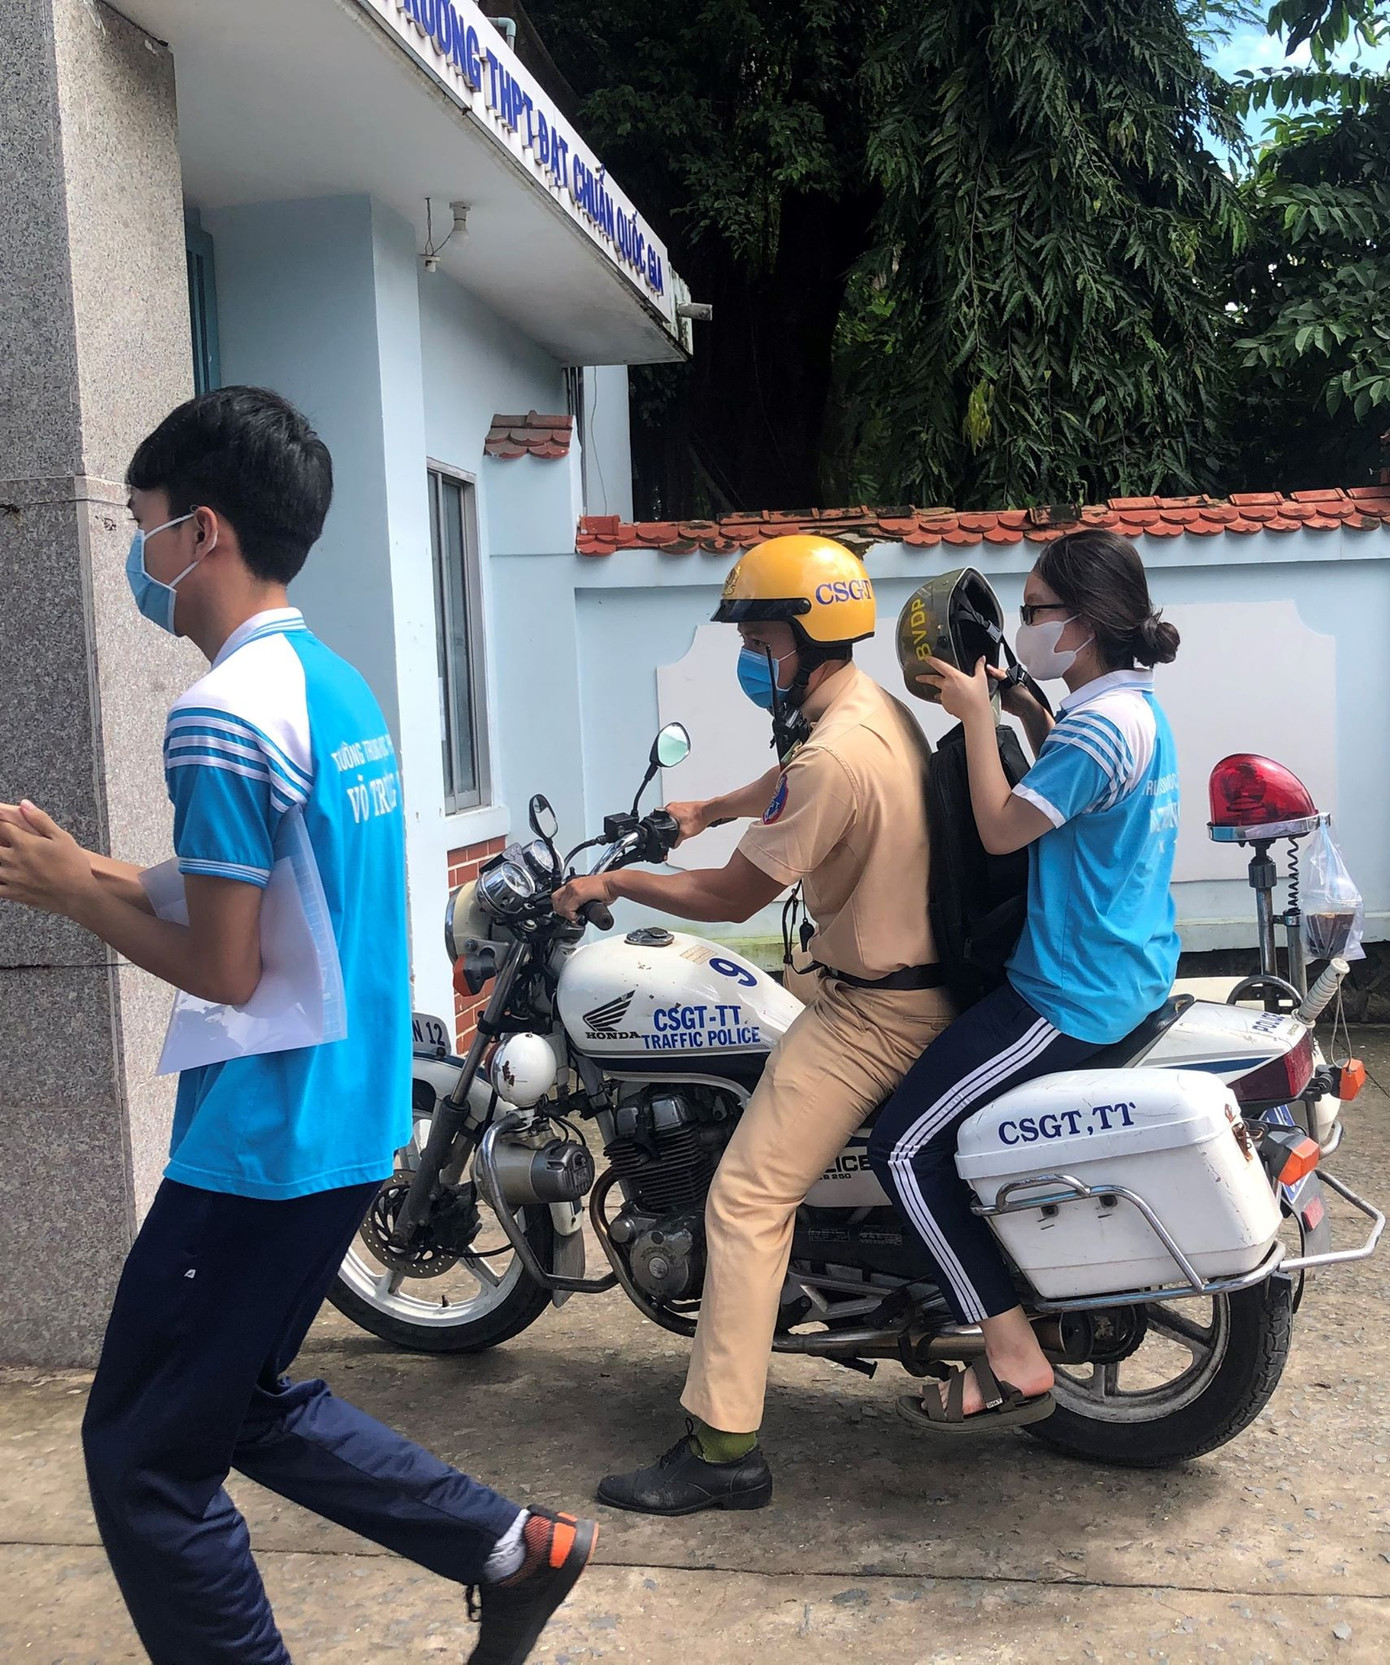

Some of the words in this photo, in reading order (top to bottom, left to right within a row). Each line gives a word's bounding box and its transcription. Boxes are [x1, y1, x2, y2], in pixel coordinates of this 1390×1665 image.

[485, 47, 533, 149] THPT
[648, 244, 664, 296] GIA
[911, 599, 932, 661] BVDP
[709, 958, 757, 987] 9
[653, 1005, 742, 1032] CSGT-TT
[425, 1021, 446, 1046] 12
[585, 1031, 642, 1040] HONDA
[641, 1031, 703, 1050] TRAFFIC
[707, 1027, 761, 1047] POLICE
